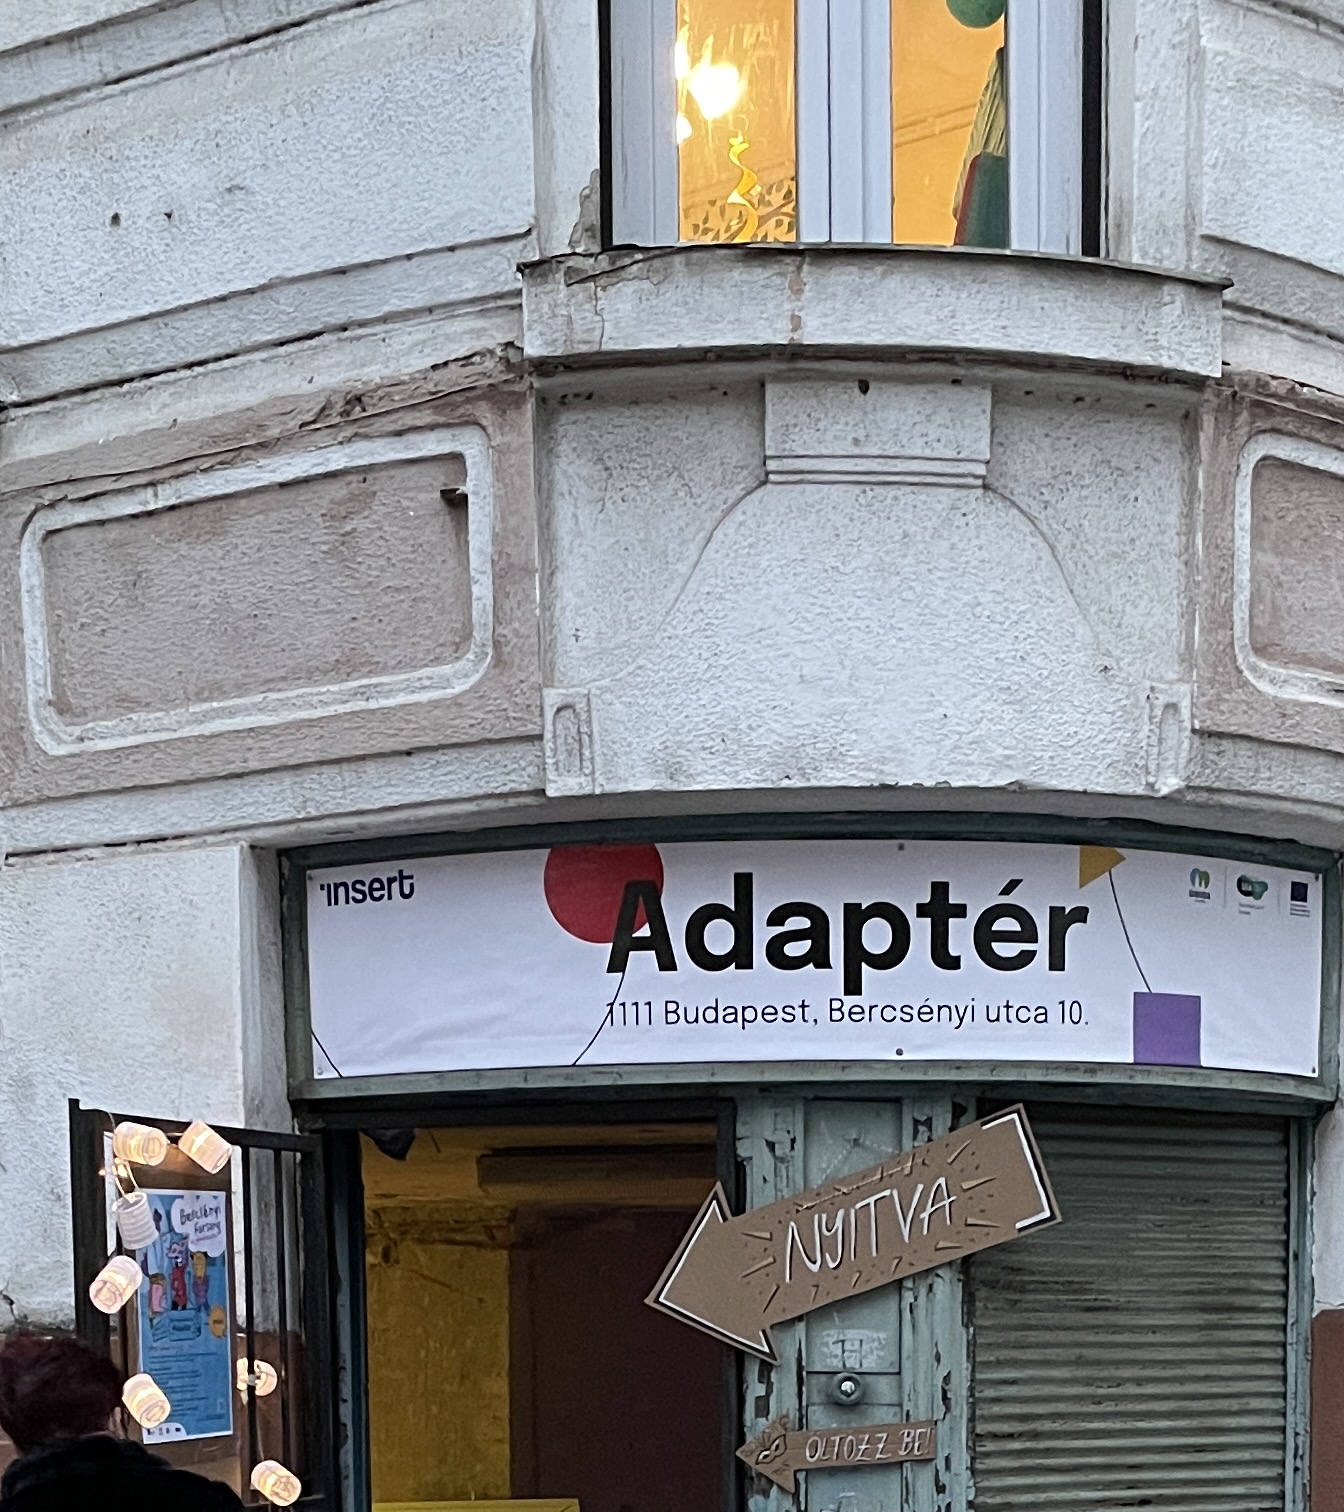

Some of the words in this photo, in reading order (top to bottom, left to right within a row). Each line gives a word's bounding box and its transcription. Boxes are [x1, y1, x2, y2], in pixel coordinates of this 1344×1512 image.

[320, 869, 414, 906] insert
[606, 872, 1090, 996] Adaptér
[607, 1001, 653, 1026] 1111
[665, 998, 818, 1030] Budapest,
[830, 996, 976, 1029] Bercsényi
[986, 1001, 1049, 1024] utca
[1057, 1000, 1090, 1025] 10.
[786, 1176, 956, 1283] NYITVA
